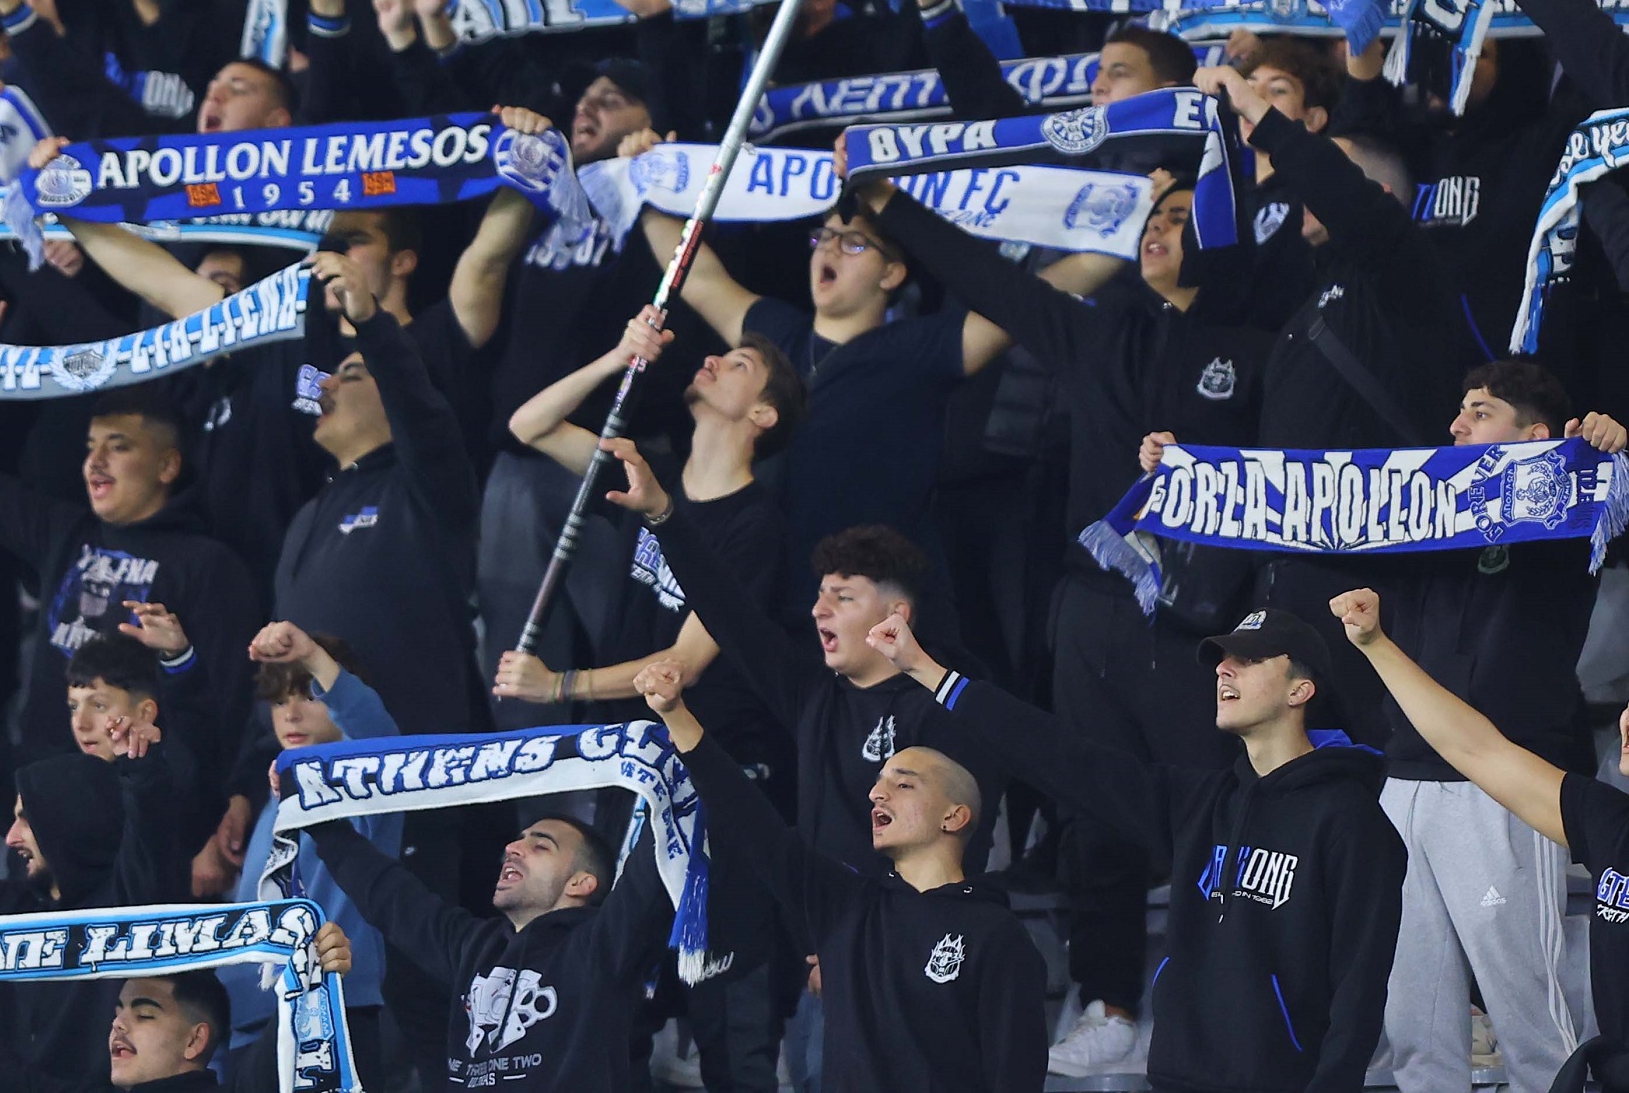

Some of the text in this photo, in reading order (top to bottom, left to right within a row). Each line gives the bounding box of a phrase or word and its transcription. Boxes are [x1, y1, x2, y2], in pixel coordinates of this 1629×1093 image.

[96, 140, 291, 190] APOLLON
[301, 122, 492, 175] LEMESOS
[868, 120, 998, 163] ΘΥΡΑ
[232, 178, 351, 209] 1954
[958, 168, 1021, 215] FC
[1283, 461, 1457, 543] APOLLON
[293, 733, 564, 812] ATHENS
[512, 1053, 543, 1070] TWO
